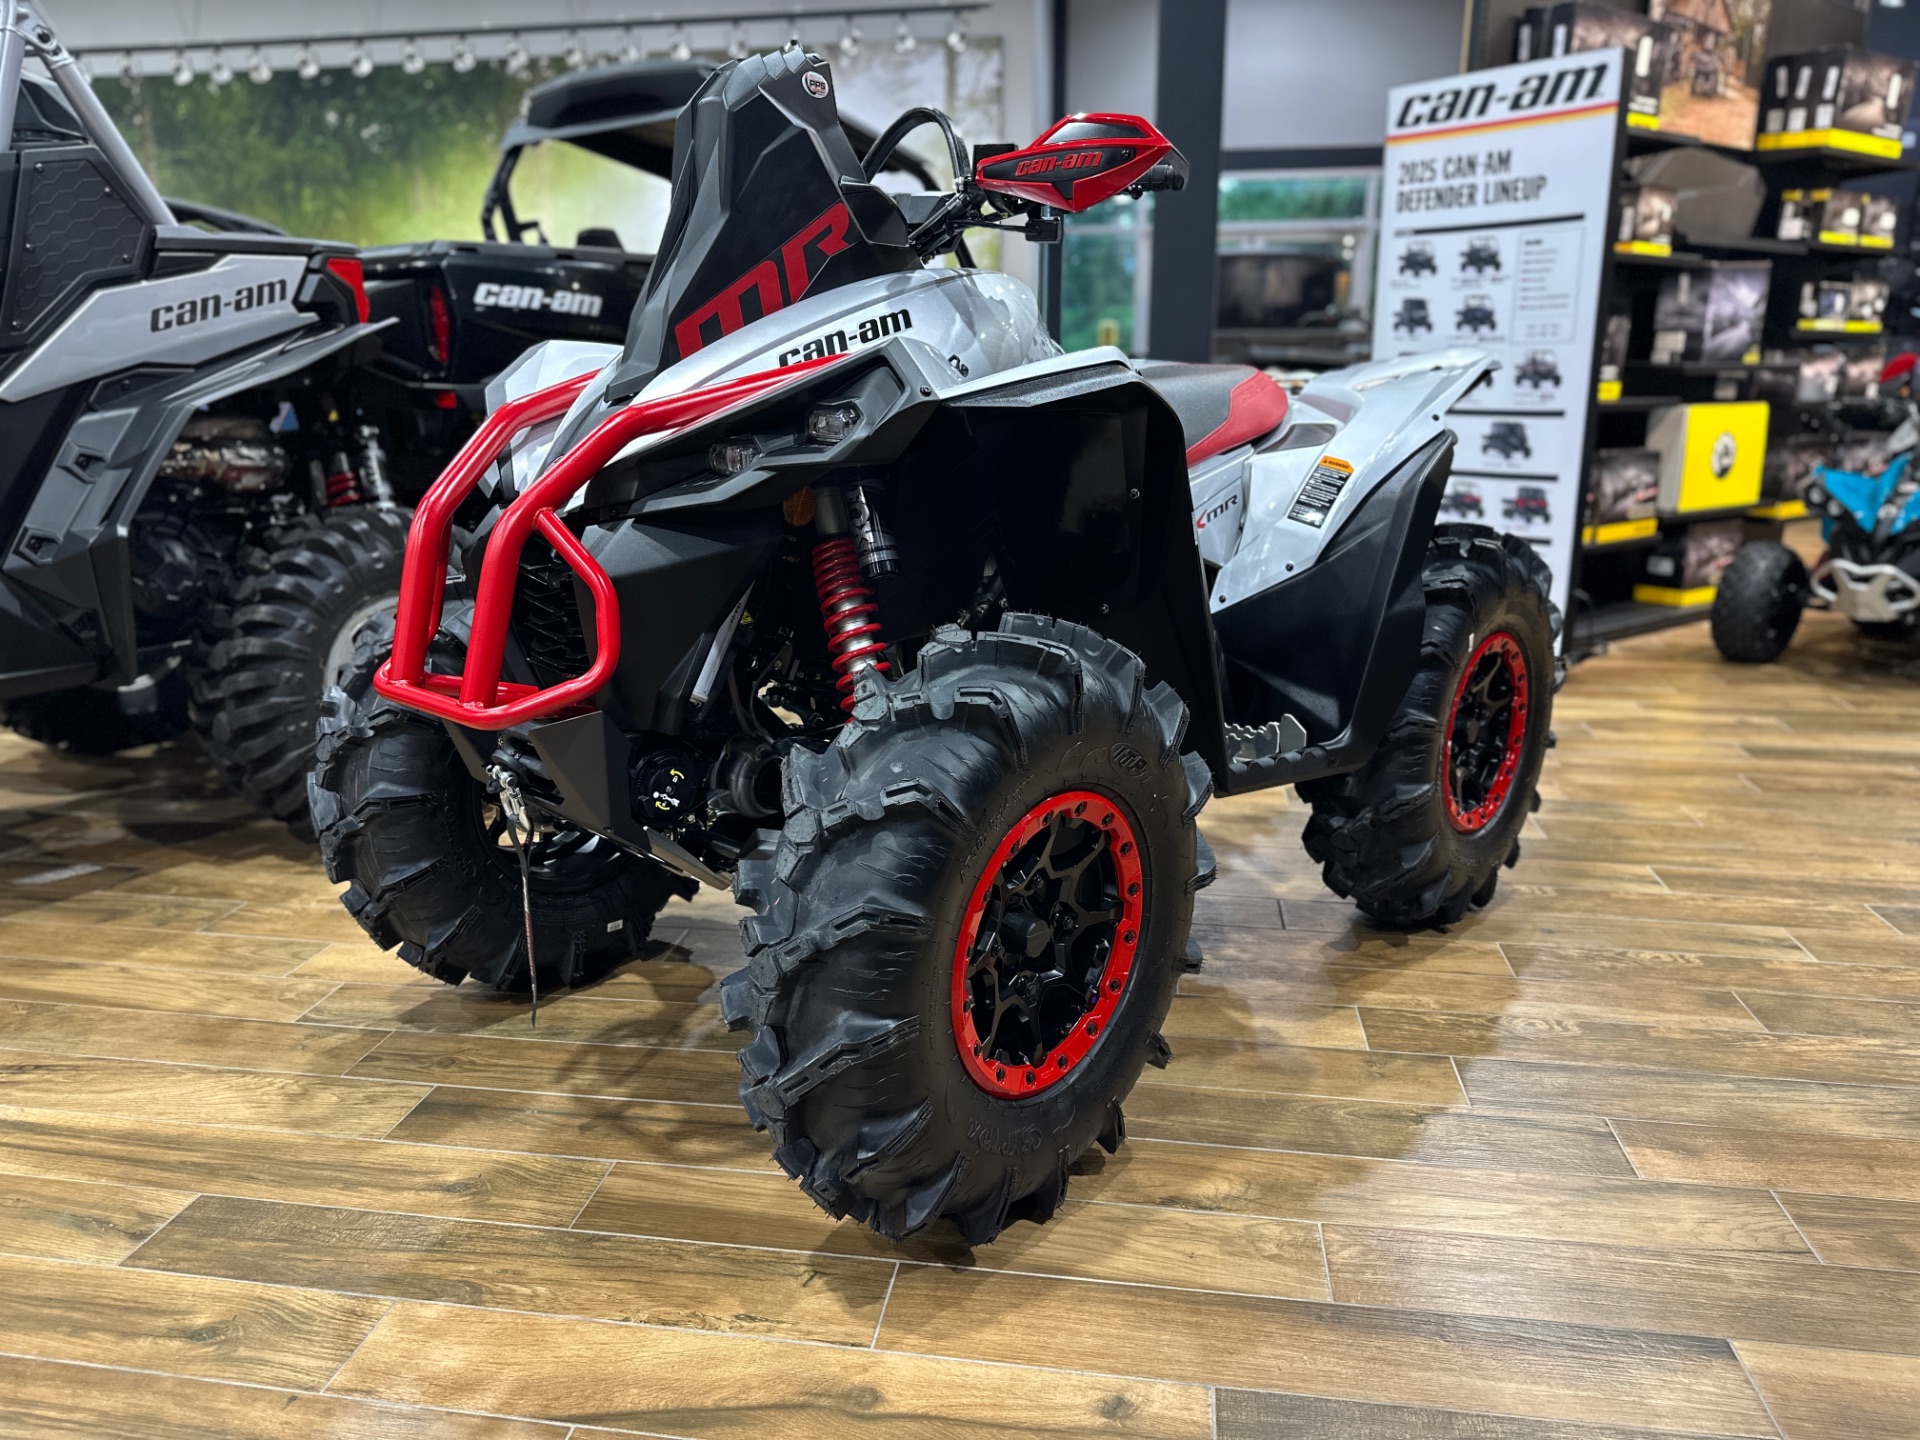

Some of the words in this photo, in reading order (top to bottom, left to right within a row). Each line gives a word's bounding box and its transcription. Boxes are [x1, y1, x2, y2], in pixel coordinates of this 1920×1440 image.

[1396, 63, 1608, 128] can-am
[1015, 149, 1103, 176] can-am
[1398, 158, 1437, 185] 2025
[1443, 149, 1512, 180] CAN-AM
[1396, 183, 1478, 213] DEFENDER
[1484, 174, 1548, 205] LINEUP
[150, 278, 287, 333] can-am
[473, 282, 603, 318] can-am
[778, 308, 913, 368] can-am
[1112, 745, 1148, 773] ITP
